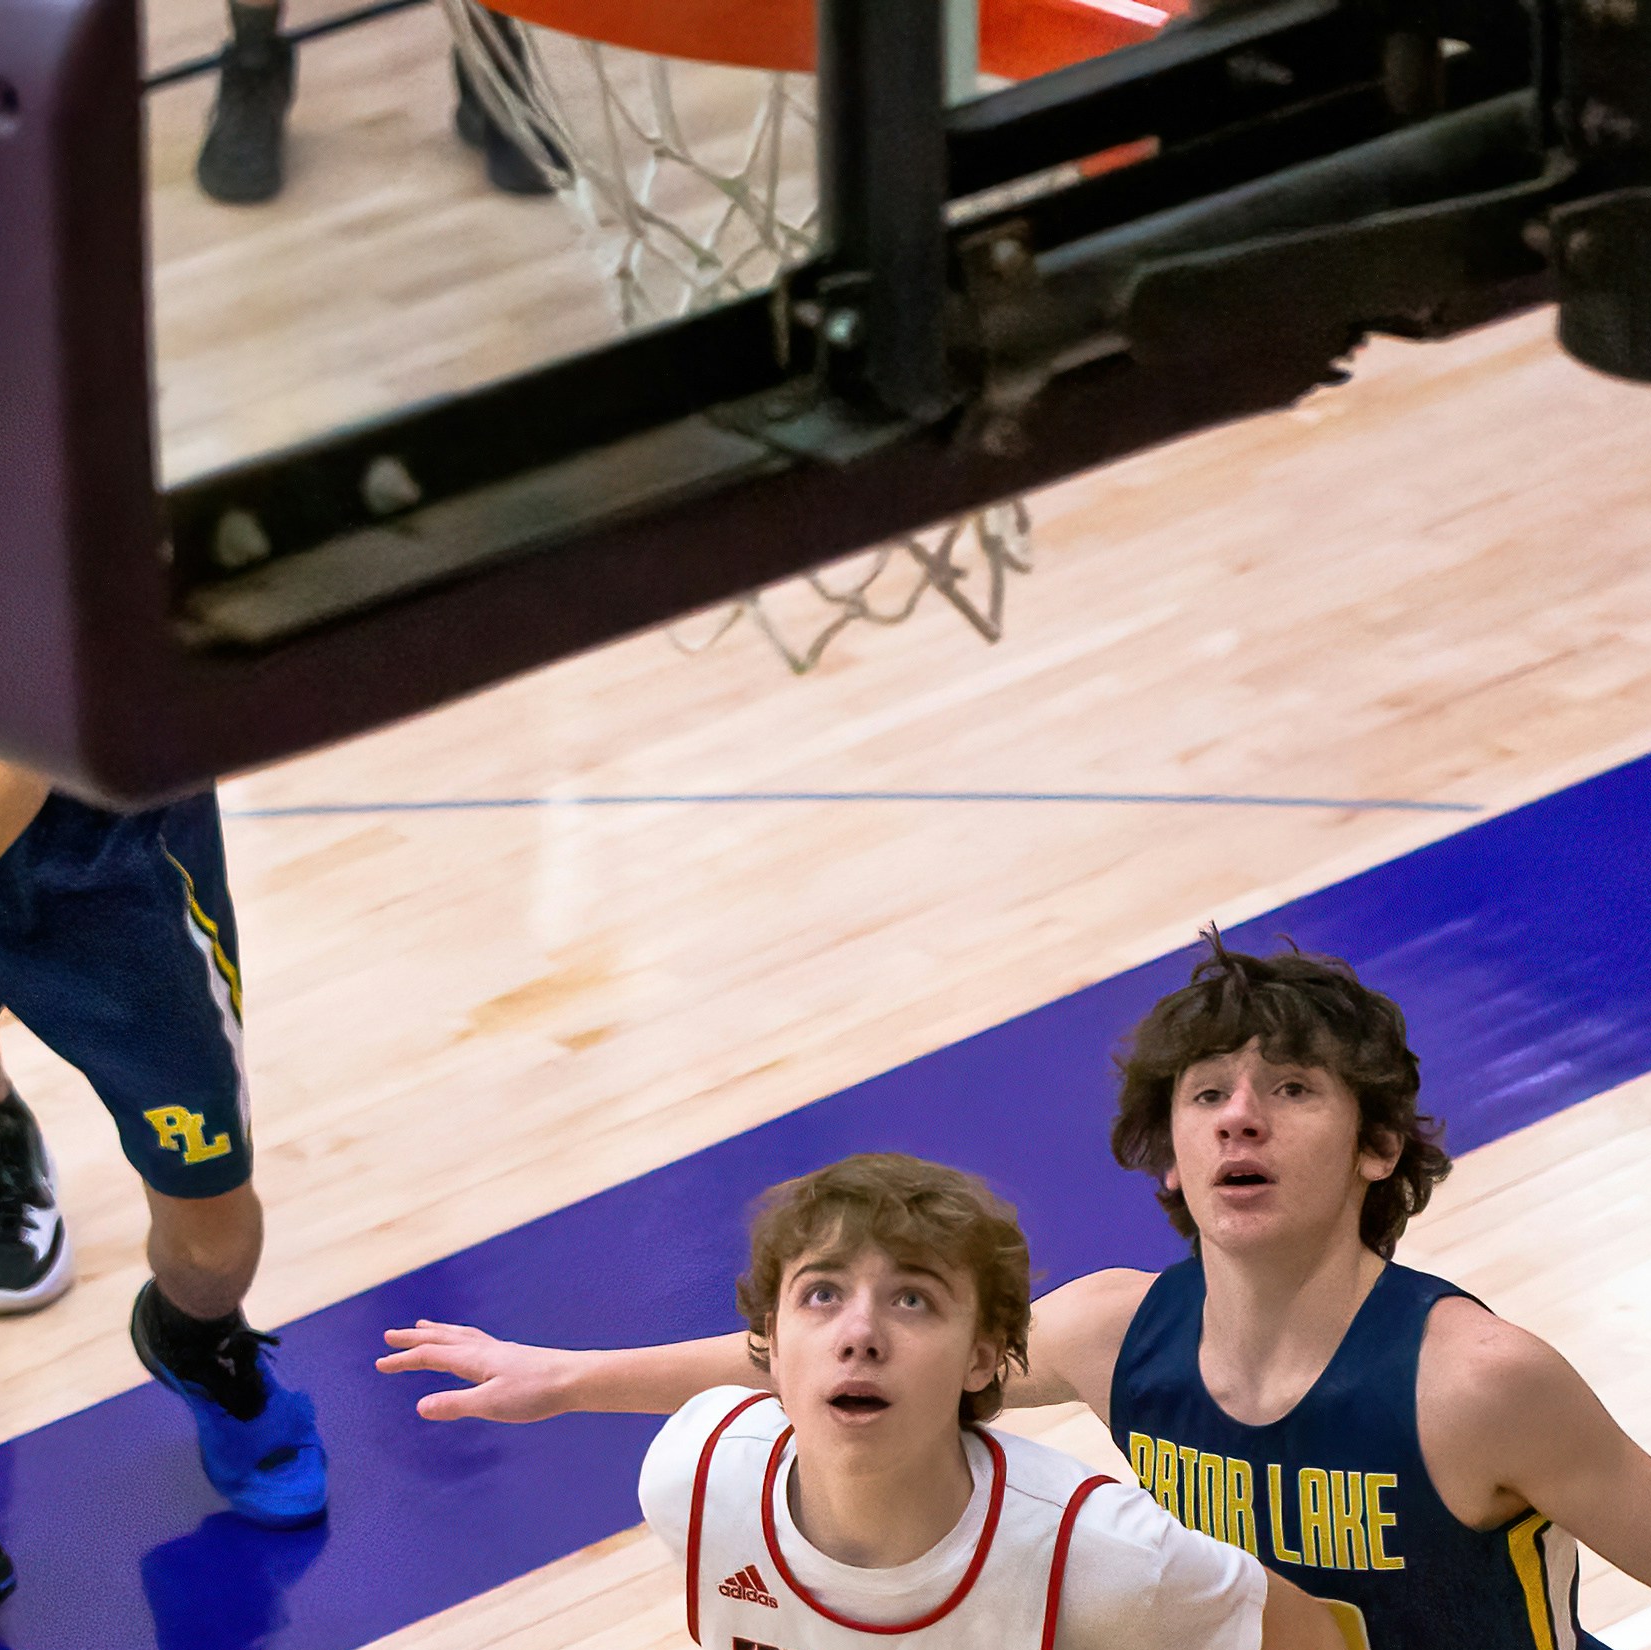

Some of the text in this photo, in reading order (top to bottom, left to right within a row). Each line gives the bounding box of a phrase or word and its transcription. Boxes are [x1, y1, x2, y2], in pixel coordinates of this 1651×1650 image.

[1129, 1431, 1405, 1571] PRIOR LAKE
[717, 1583, 779, 1609] adidas
